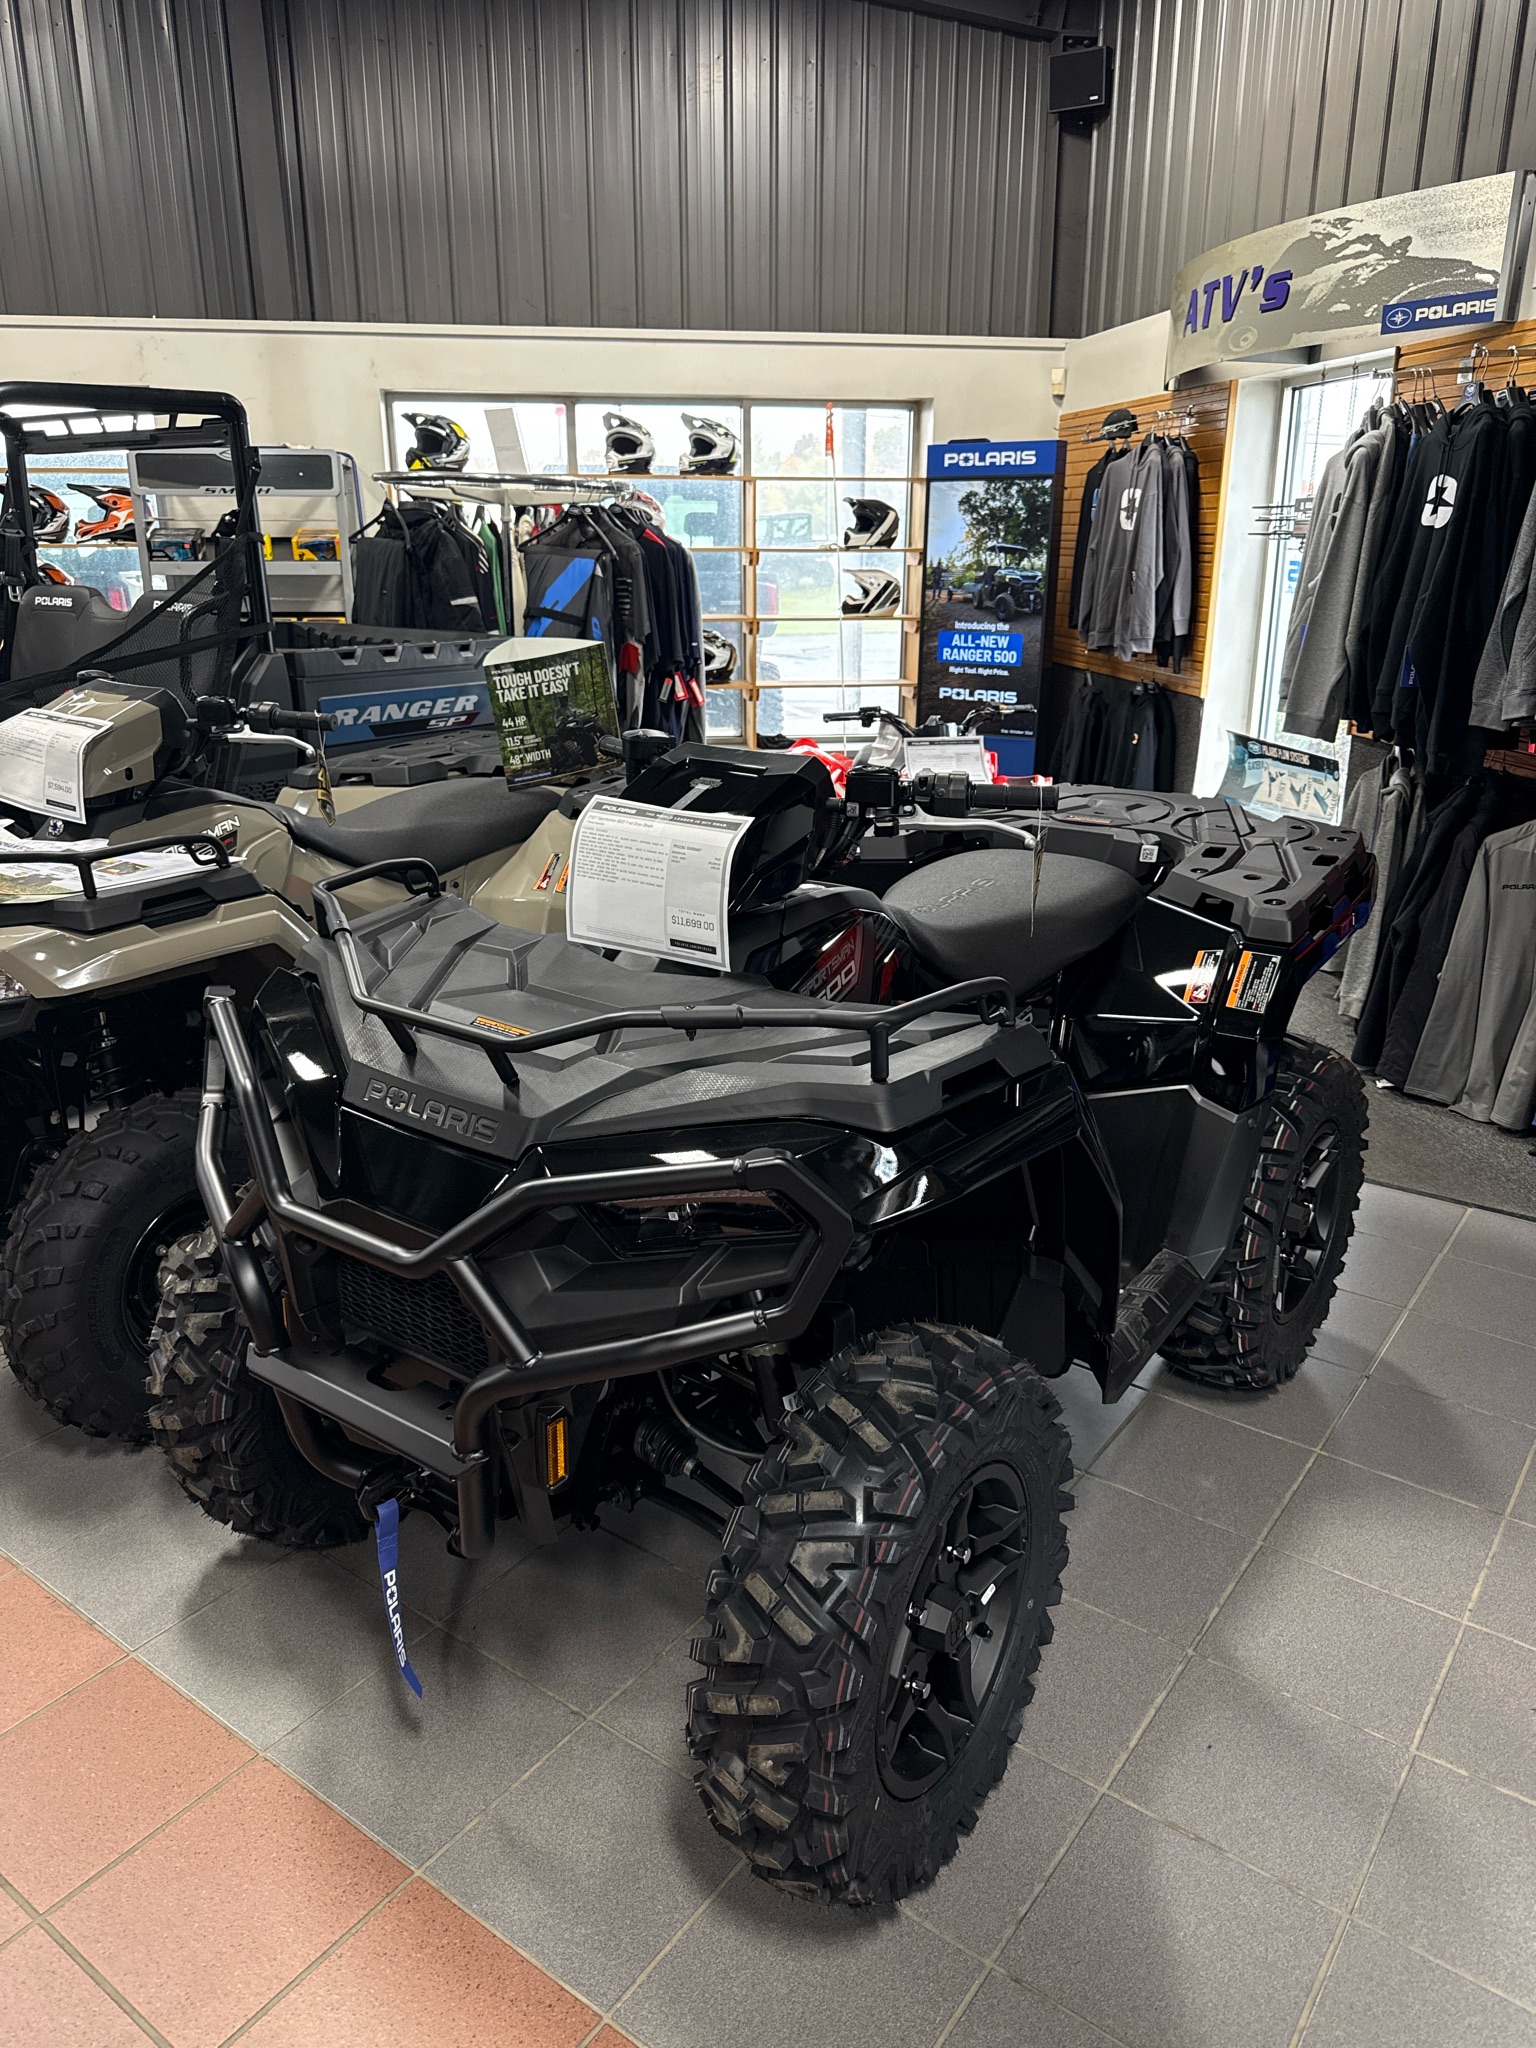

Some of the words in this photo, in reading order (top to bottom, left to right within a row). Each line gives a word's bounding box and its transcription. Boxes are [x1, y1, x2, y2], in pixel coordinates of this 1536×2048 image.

[1183, 265, 1293, 339] ATV's
[1415, 297, 1498, 322] POLARIS
[943, 450, 1037, 467] POLARIS
[203, 487, 271, 495] SMH
[34, 596, 73, 608] POLARIS
[954, 621, 996, 632] Introducing
[996, 622, 1010, 631] the
[951, 634, 1010, 648] ALL-NEW
[942, 647, 992, 662] RANGER
[993, 650, 1017, 664] 500
[493, 670, 533, 690] TOUGH
[533, 661, 580, 682] DOESN'T
[948, 666, 964, 674] Right
[977, 667, 993, 676] Right
[495, 687, 528, 703] TAKE
[528, 684, 541, 699] IT
[541, 678, 570, 696] EASY
[939, 687, 1018, 704] POLARIS
[336, 695, 479, 727] RANGER
[426, 715, 468, 729] SP
[502, 718, 515, 728] 44
[515, 715, 527, 727] HP
[525, 748, 552, 763] WIDTH
[601, 804, 638, 814] POLARIS
[671, 915, 715, 931] $11,699.00
[799, 935, 856, 996] SPORTSMAN
[363, 1077, 499, 1144] POLARIS
[383, 1569, 408, 1668] POLARIS
